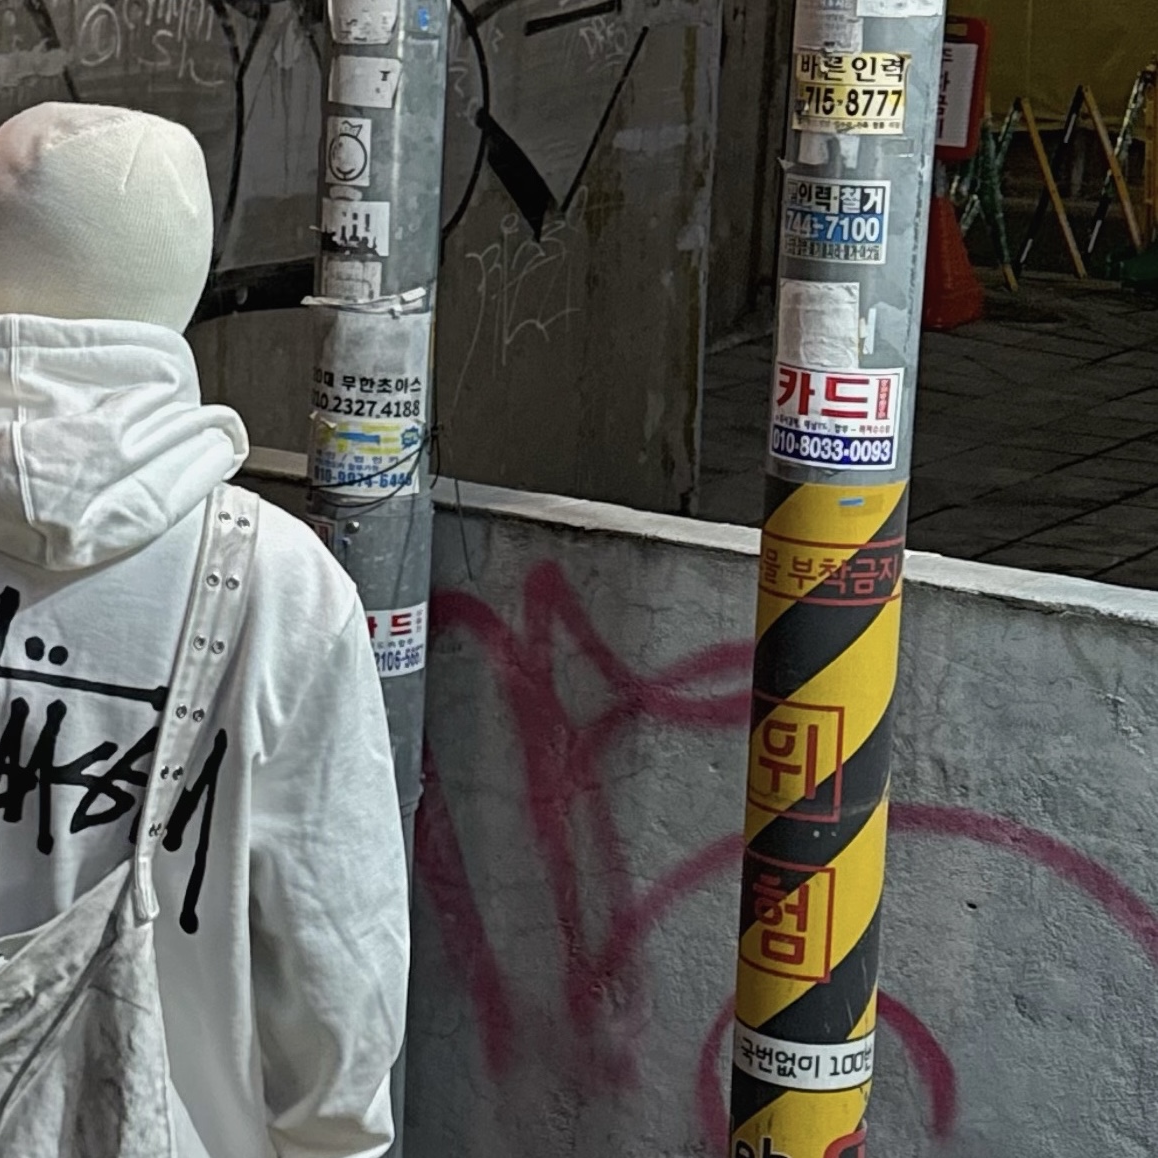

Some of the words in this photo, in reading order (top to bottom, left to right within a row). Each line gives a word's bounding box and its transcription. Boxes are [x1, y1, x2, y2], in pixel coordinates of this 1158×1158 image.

[341, 374, 422, 394] 무한초이스
[776, 367, 870, 420] 카드
[787, 554, 898, 595] 부착금지
[740, 1036, 820, 1079] 국번없이
